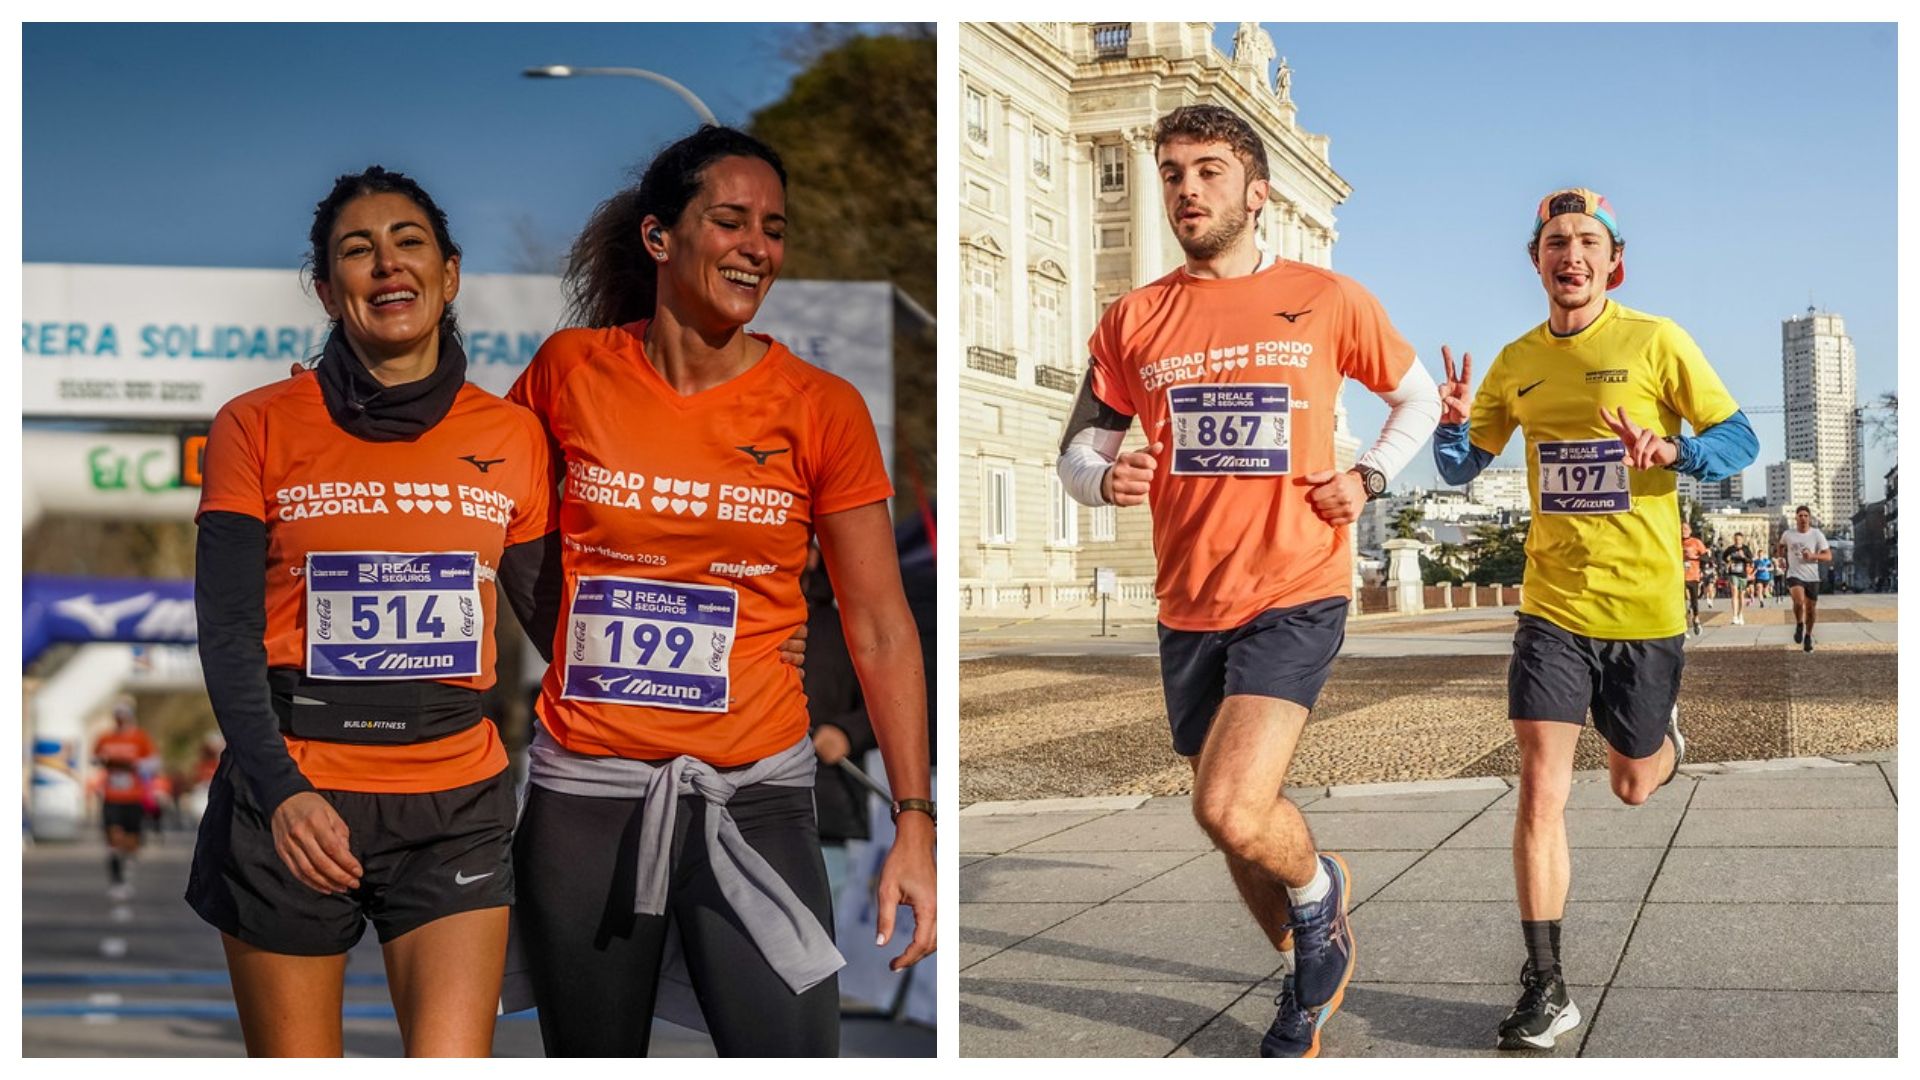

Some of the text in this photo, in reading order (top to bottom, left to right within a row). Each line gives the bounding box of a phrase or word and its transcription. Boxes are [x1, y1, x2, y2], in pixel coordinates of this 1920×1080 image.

[1139, 341, 1313, 379] SOLEDAD FONDO
[1144, 353, 1309, 392] CAZORLA BECAS
[1217, 392, 1254, 401] REALE
[1197, 415, 1261, 446] 867
[1568, 446, 1598, 454] REALE
[1557, 466, 1606, 491] 197
[276, 481, 516, 512] SOLEDAD FONDO
[718, 484, 794, 508] FONDO
[279, 498, 389, 521] CAZORLA
[717, 502, 788, 525] BECAS
[381, 563, 431, 574] REALE
[637, 553, 667, 566] 2025
[709, 560, 778, 578] mujeres
[381, 574, 432, 583] SEGUROS
[634, 602, 687, 615] SEGUROS
[635, 591, 687, 606] REALE
[352, 595, 445, 640] 514
[604, 620, 694, 669] 199
[343, 720, 407, 730] BUILD&FITNESS
